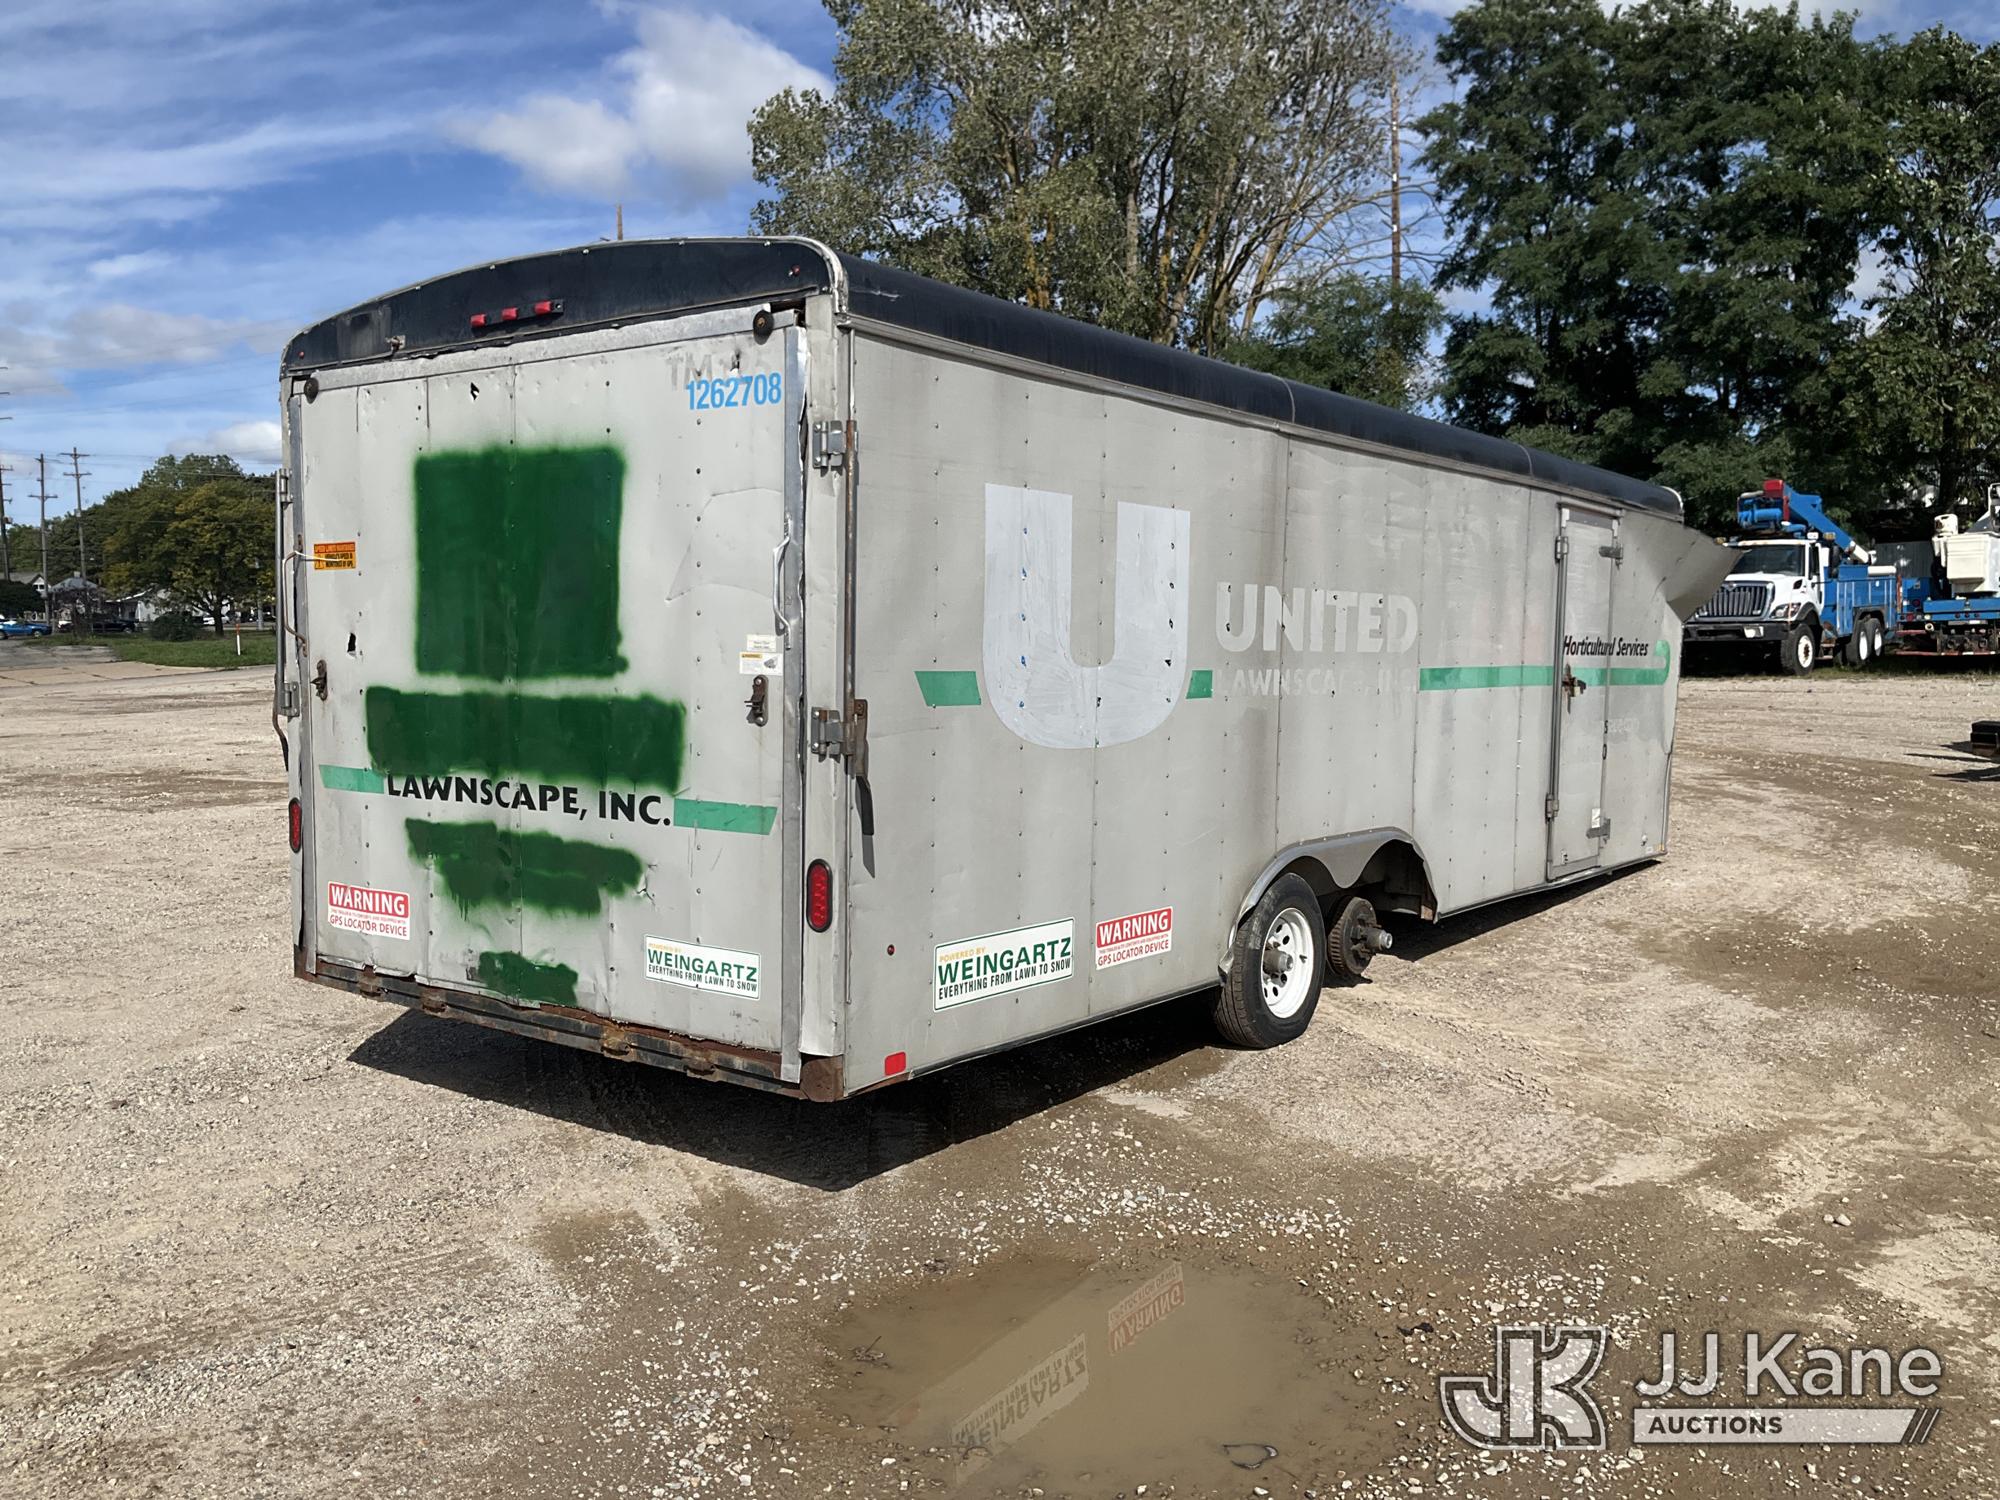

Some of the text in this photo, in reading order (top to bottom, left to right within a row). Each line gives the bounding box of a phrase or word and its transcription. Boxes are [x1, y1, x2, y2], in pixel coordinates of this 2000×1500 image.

[686, 371, 782, 410] 1262708
[983, 483, 1190, 749] U
[1216, 581, 1418, 654] UNITED
[1616, 636, 1649, 657] Services
[387, 774, 671, 827] LAWNSCAPE, INC.
[331, 885, 405, 916] WARNING
[330, 915, 343, 926] GPS
[344, 917, 377, 931] LOCATOR
[379, 923, 407, 936] DEVICE
[1099, 911, 1168, 946] WARNING
[648, 949, 757, 982] WEINGARTZ
[938, 937, 1071, 986] WEINGARTZ
[940, 946, 986, 962] POWERED BY
[1097, 954, 1112, 966] GPS
[1113, 946, 1143, 962] LOCATOR
[1145, 940, 1169, 954] DEVICE
[649, 964, 757, 992] EVERYTHING FROM LAWN TO SNOW
[939, 957, 1071, 1000] EVERYTHING FROM LAWN TO SNOW
